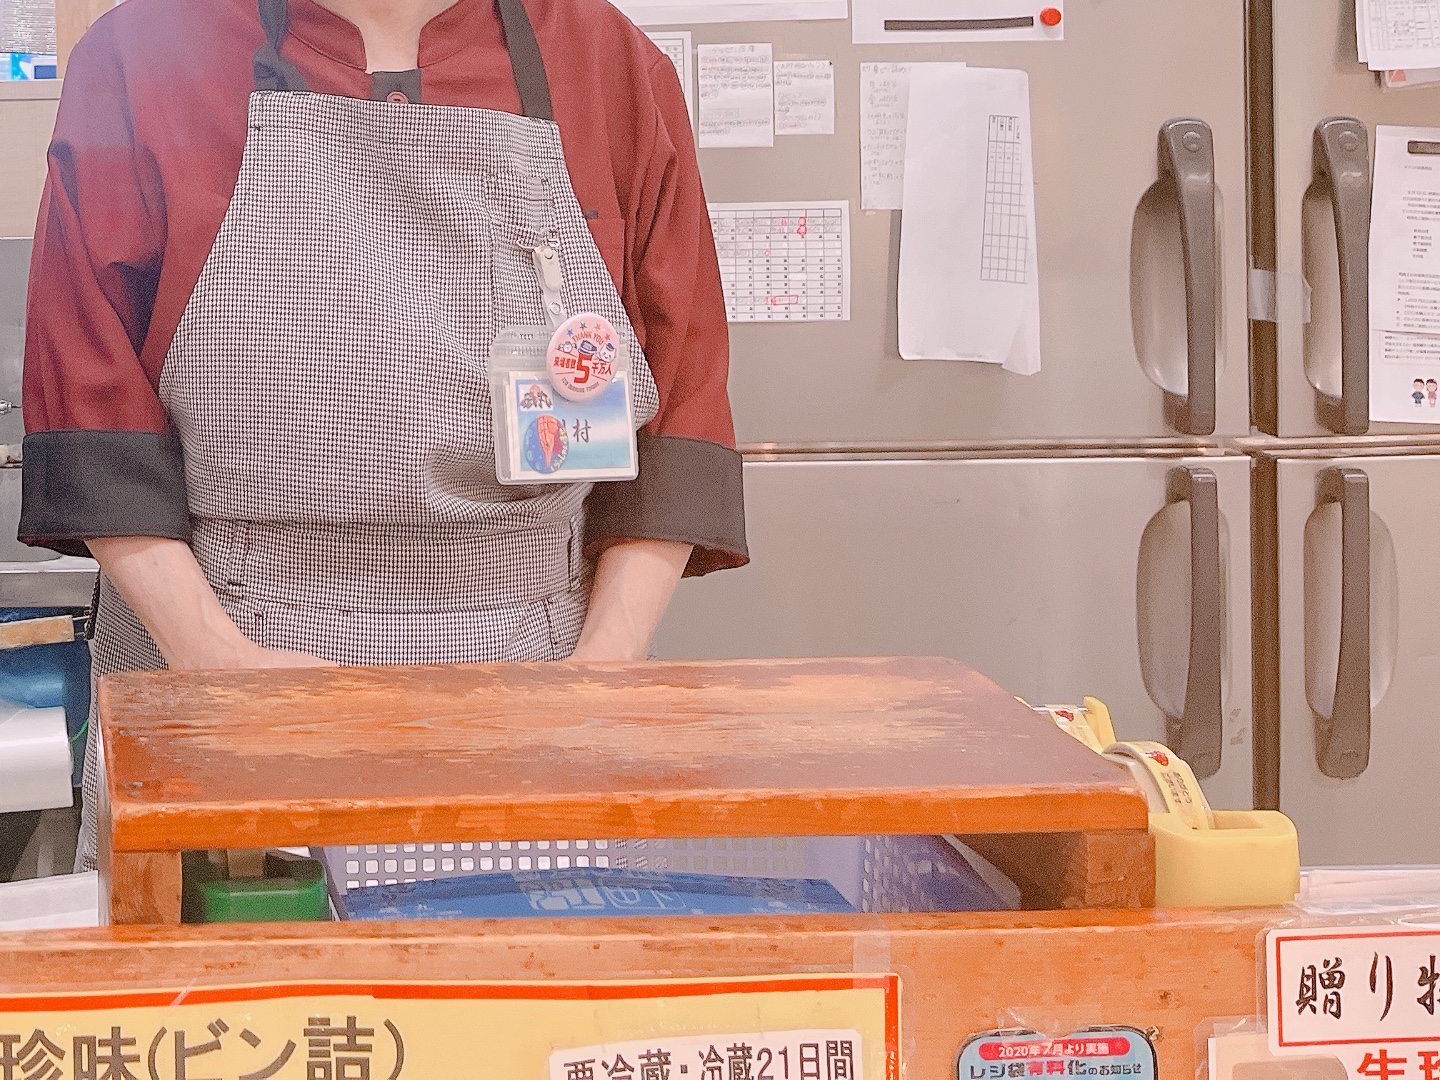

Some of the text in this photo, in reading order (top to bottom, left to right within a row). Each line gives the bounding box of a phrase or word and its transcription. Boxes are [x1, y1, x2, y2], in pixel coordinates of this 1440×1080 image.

[998, 1041, 1109, 1058] 2020年7月より実施
[970, 1059, 1143, 1080] レジ袋有料化のお知らせ
